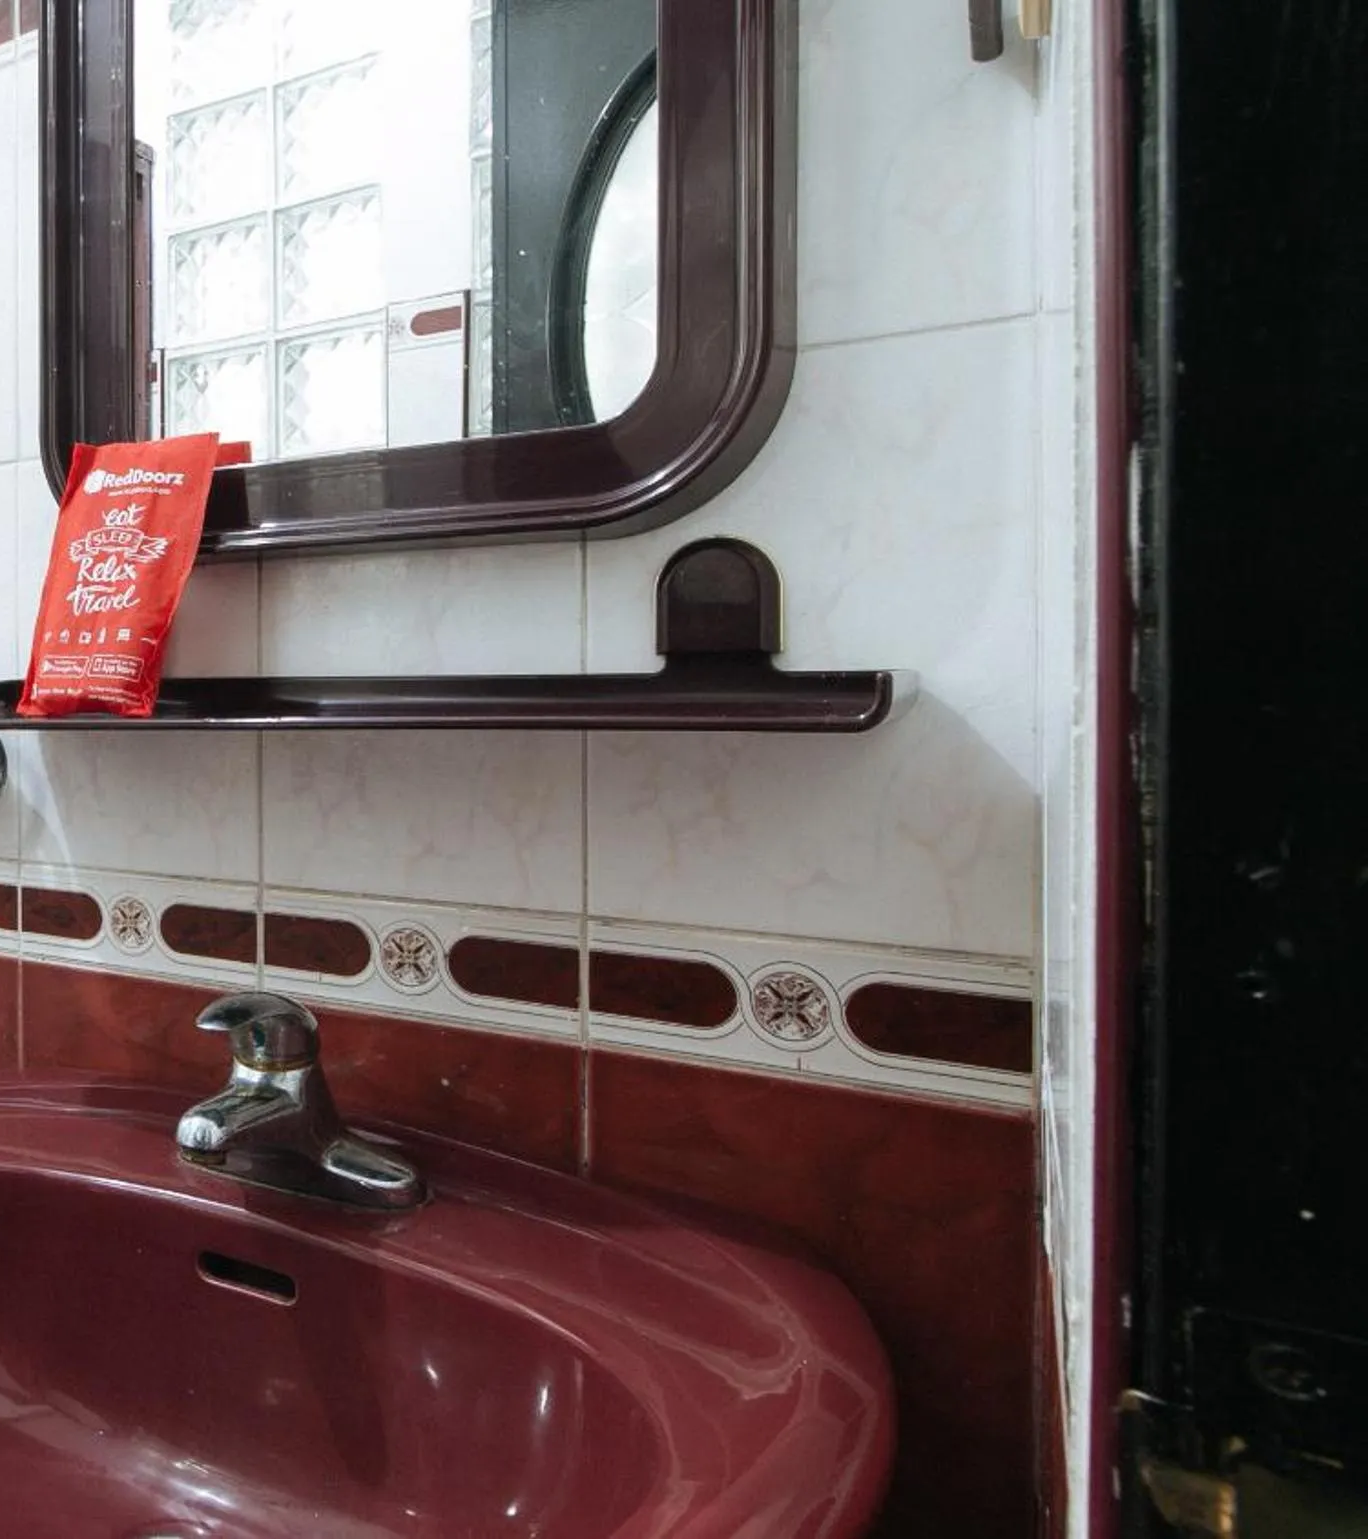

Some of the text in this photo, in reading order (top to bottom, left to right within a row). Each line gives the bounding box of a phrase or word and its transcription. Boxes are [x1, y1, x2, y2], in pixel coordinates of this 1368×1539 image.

[103, 468, 184, 488] RedDoorz
[102, 503, 147, 526] eat
[77, 554, 137, 582] Relax
